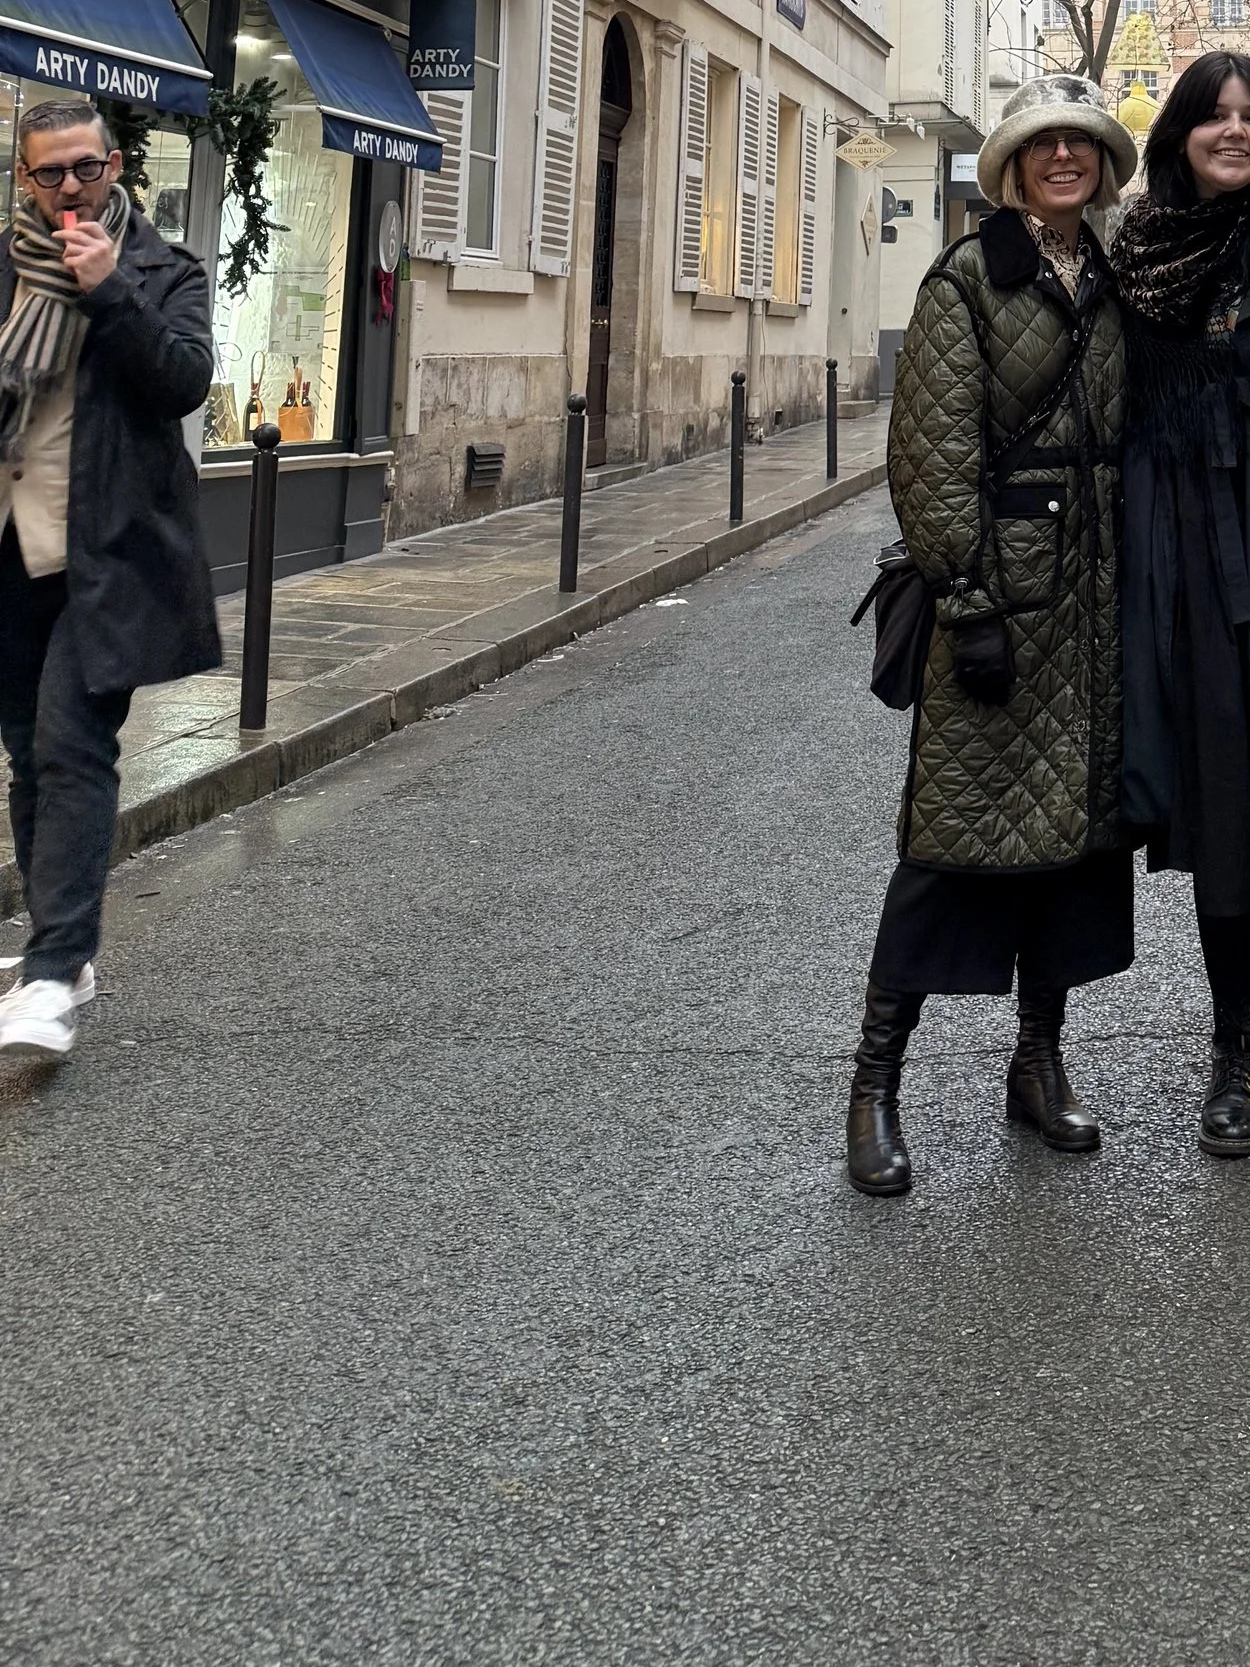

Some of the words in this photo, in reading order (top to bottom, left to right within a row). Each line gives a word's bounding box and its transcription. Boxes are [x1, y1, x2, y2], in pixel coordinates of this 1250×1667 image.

[411, 49, 460, 63] ARTY
[36, 47, 88, 85] ARTY
[97, 62, 160, 102] DANDY
[410, 64, 472, 78] DANDY
[353, 130, 381, 156] ARTY
[385, 138, 418, 164] DANDY
